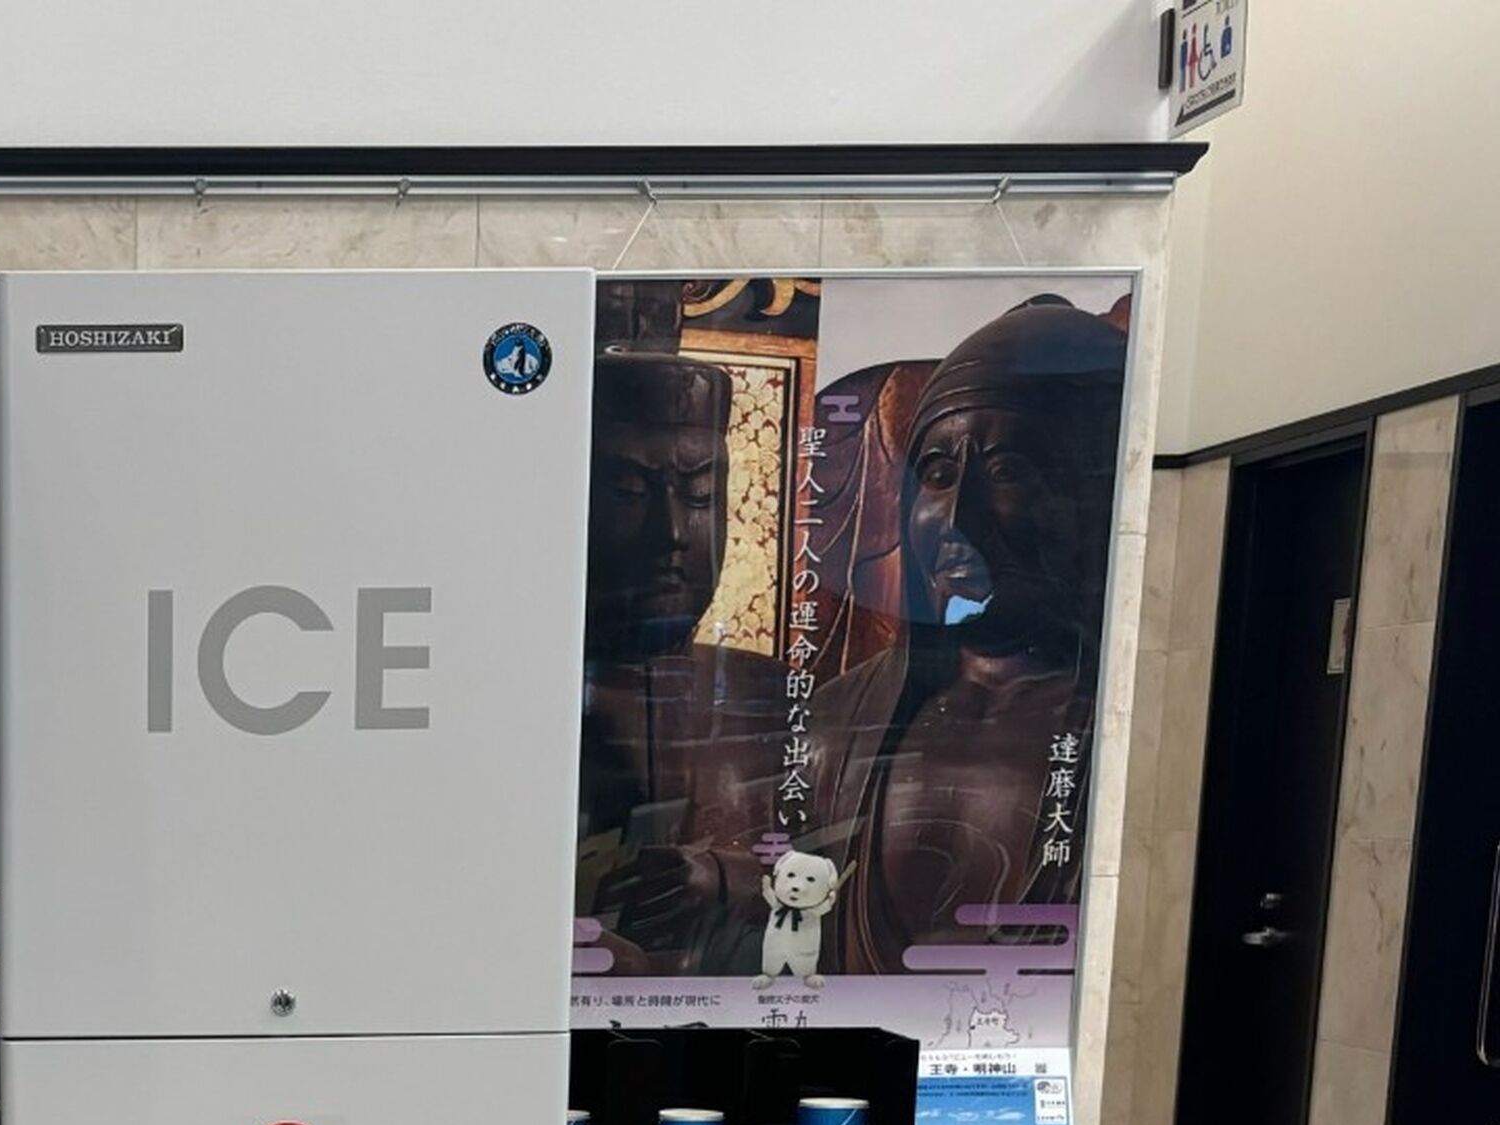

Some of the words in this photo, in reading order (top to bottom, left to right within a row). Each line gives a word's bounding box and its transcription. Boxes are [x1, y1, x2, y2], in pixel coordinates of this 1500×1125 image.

[50, 330, 170, 347] HOSHIZAKI
[147, 585, 432, 736] ICE
[778, 425, 828, 827] 聖人二人の運命的な出会い
[1042, 732, 1080, 867] 達磨大師
